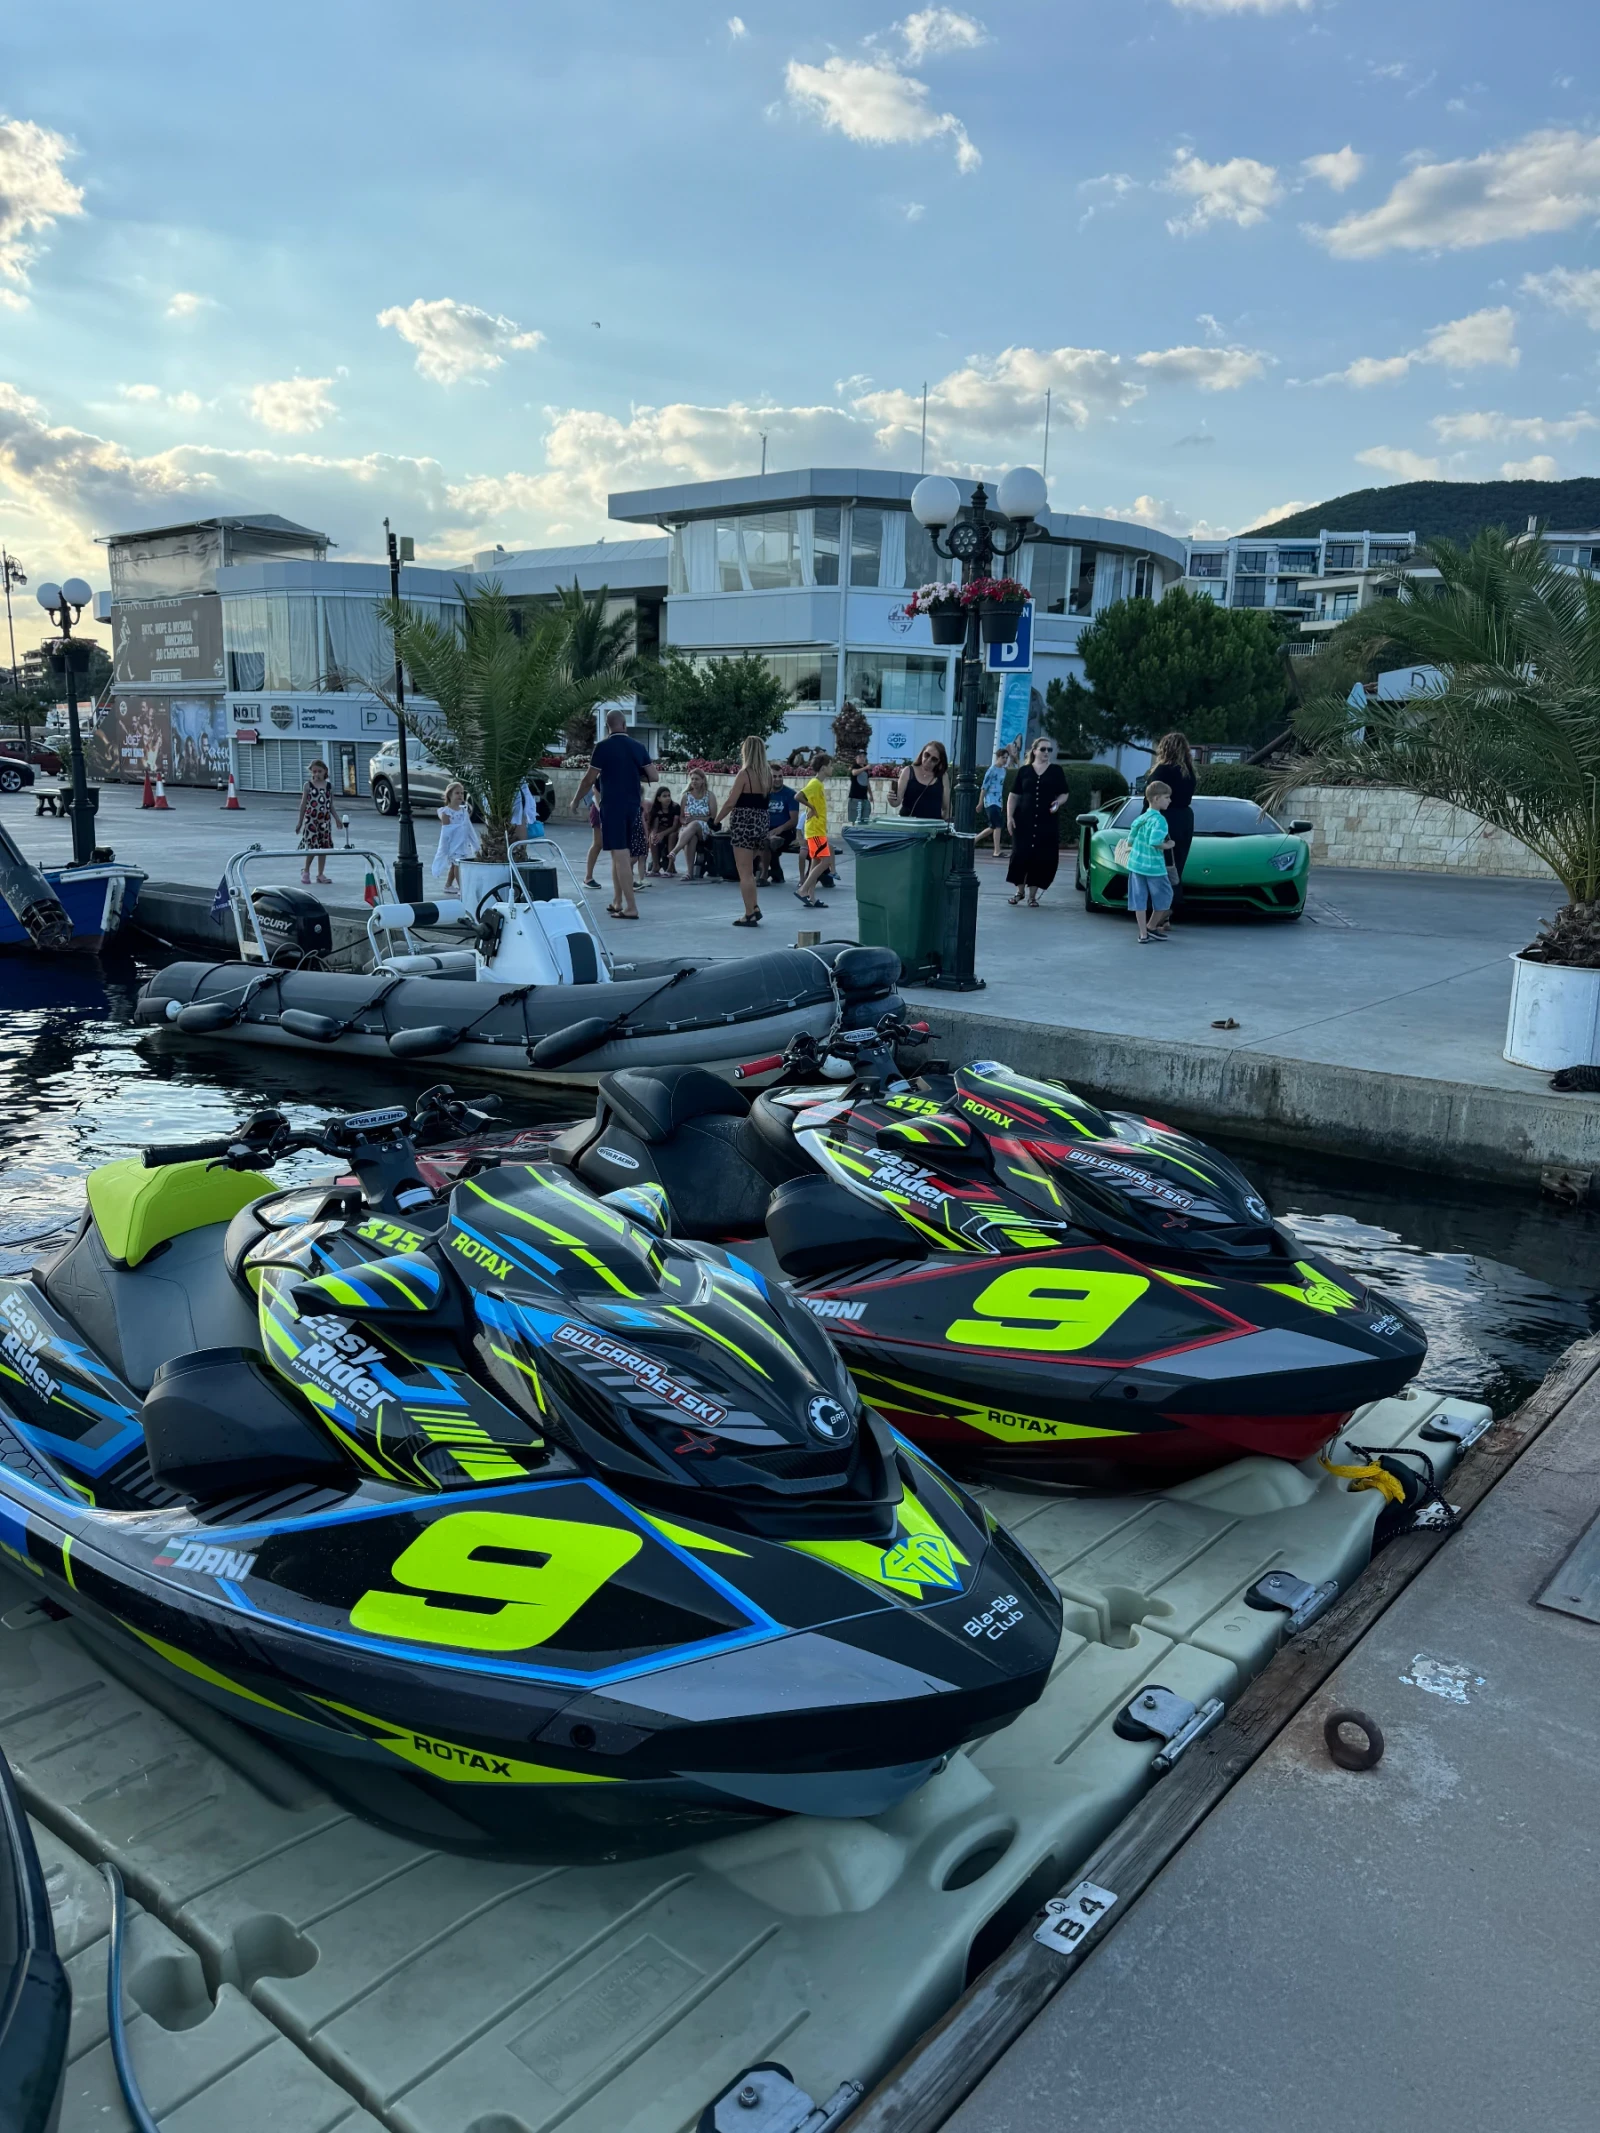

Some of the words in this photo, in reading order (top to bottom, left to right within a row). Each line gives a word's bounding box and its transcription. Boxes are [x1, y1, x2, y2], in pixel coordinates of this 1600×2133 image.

[886, 1095, 943, 1116] 325
[962, 1098, 1014, 1129] ROTAX
[863, 1147, 937, 1179] Easy
[868, 1177, 903, 1194] RACING
[905, 1191, 938, 1210] PARTS
[872, 1165, 956, 1204] Rider
[357, 1216, 426, 1254] 325
[450, 1231, 515, 1281] ROTAX
[0, 1291, 50, 1354] Easy
[945, 1266, 1150, 1351] 9
[298, 1313, 388, 1365] Easy
[1, 1329, 62, 1397] Rider
[298, 1340, 397, 1410] Rider
[291, 1360, 332, 1393] RACING
[331, 1389, 370, 1419] PARTS
[829, 1411, 846, 1425] BRP
[988, 1410, 1058, 1436] ROTAX
[176, 1542, 258, 1583] DANI
[350, 1511, 643, 1651] 9
[963, 1594, 1018, 1638] Bla-Bla
[986, 1610, 1024, 1641] Club
[413, 1734, 512, 1778] ROTAX
